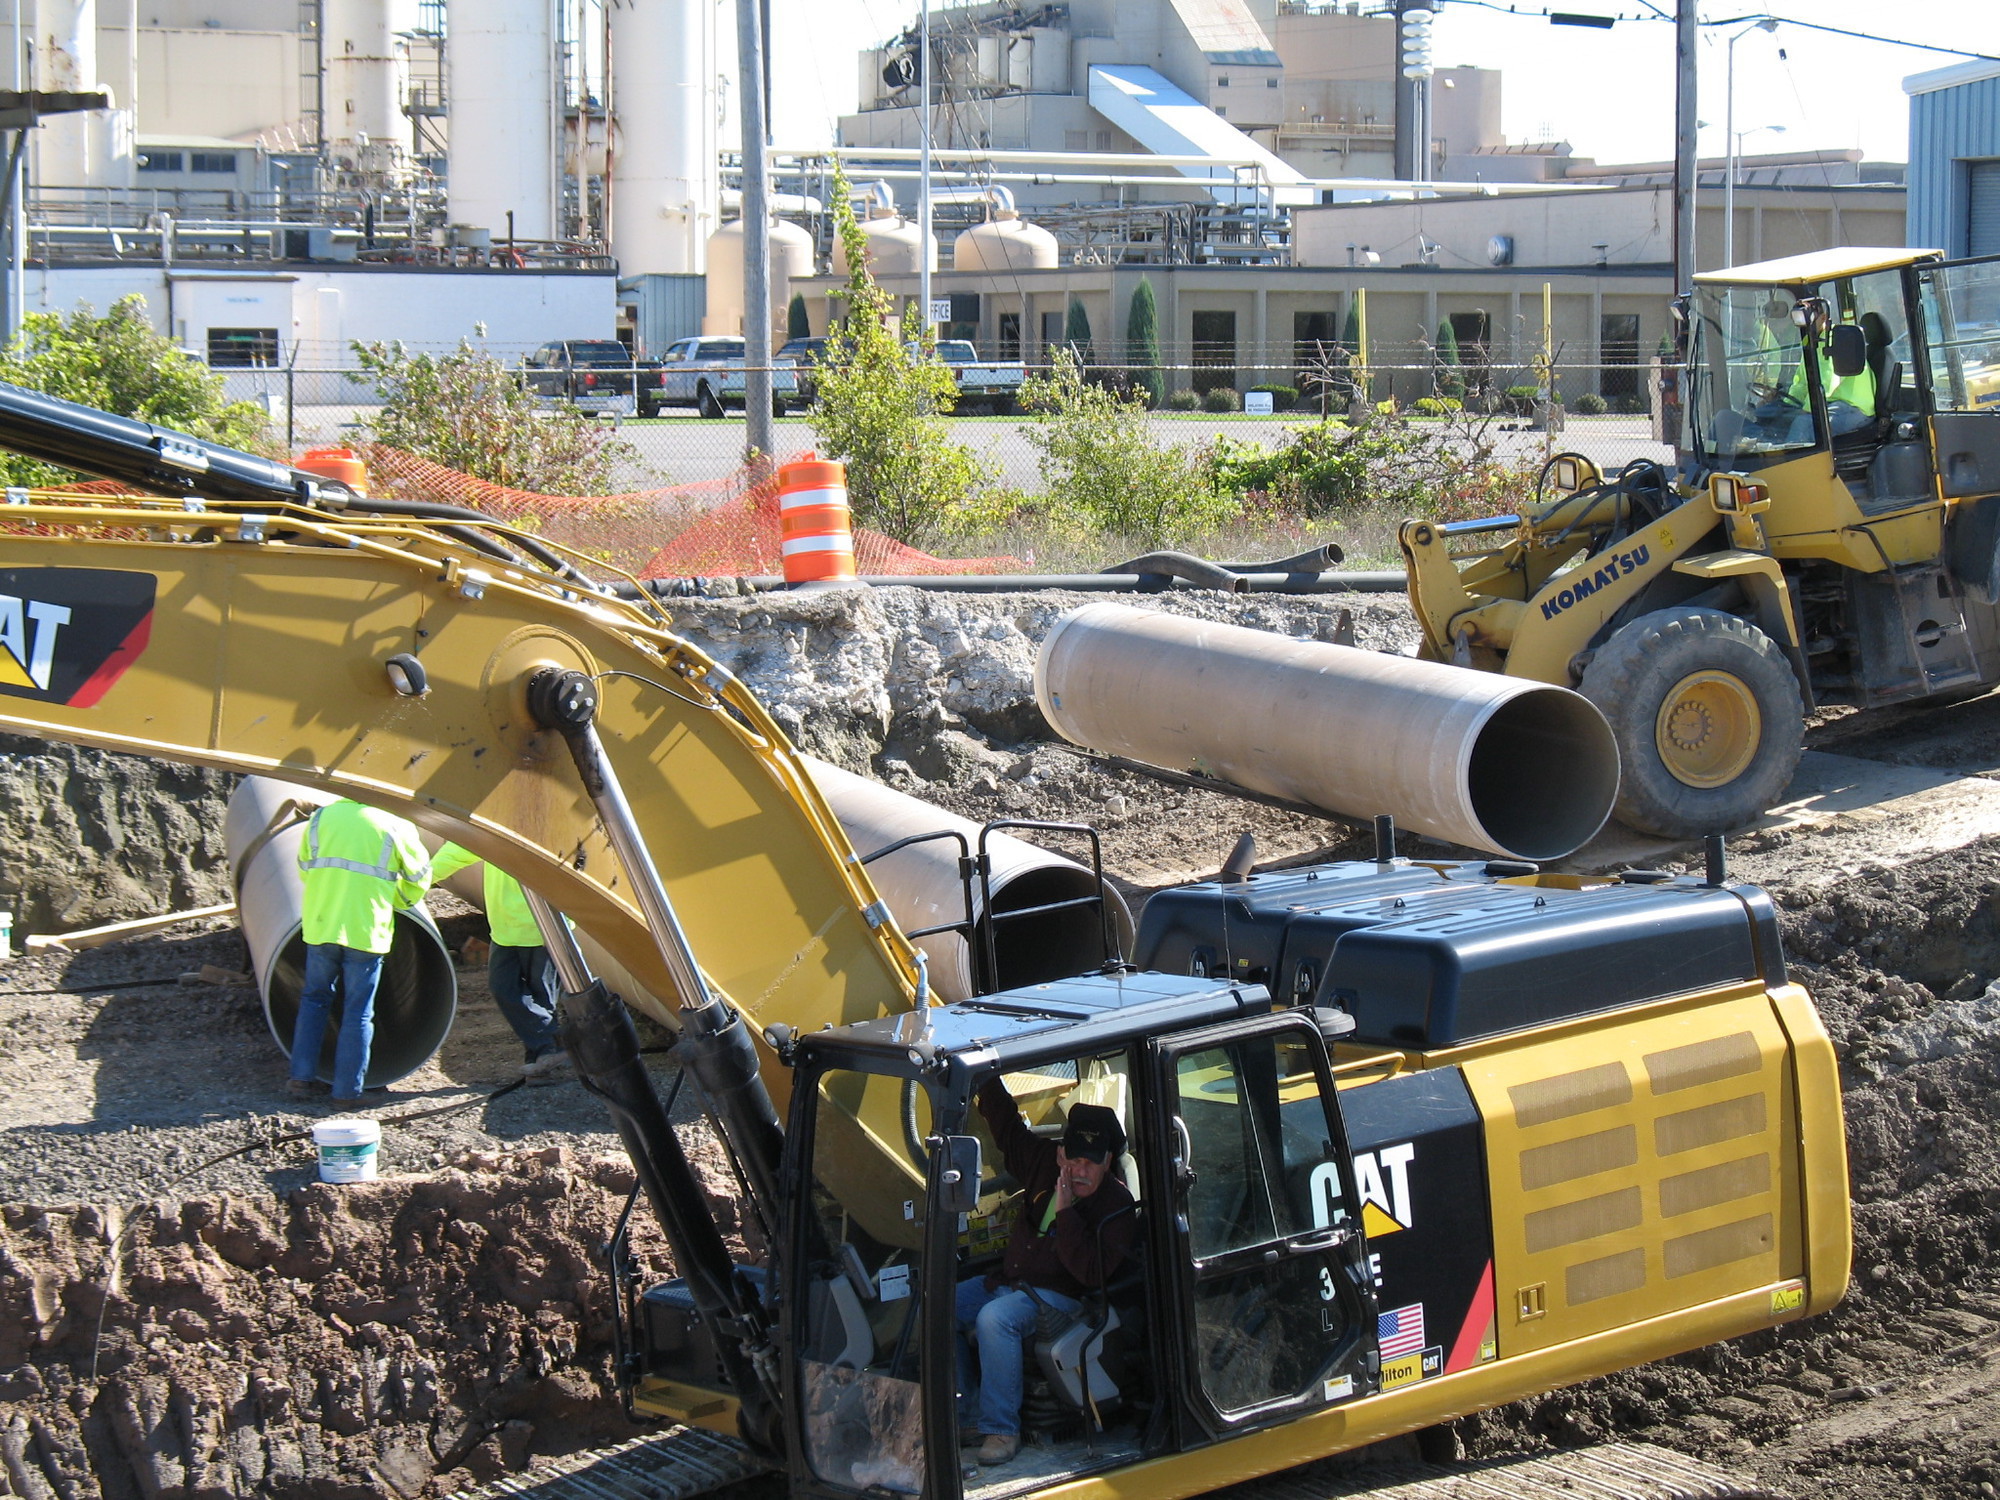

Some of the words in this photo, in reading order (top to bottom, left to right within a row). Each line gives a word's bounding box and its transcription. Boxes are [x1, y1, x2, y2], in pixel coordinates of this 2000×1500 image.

[930, 303, 949, 319] FFICE
[1540, 544, 1650, 621] KOMATSU
[0, 593, 72, 691] AT
[1310, 1142, 1415, 1229] CAT
[1422, 1355, 1439, 1372] CAT
